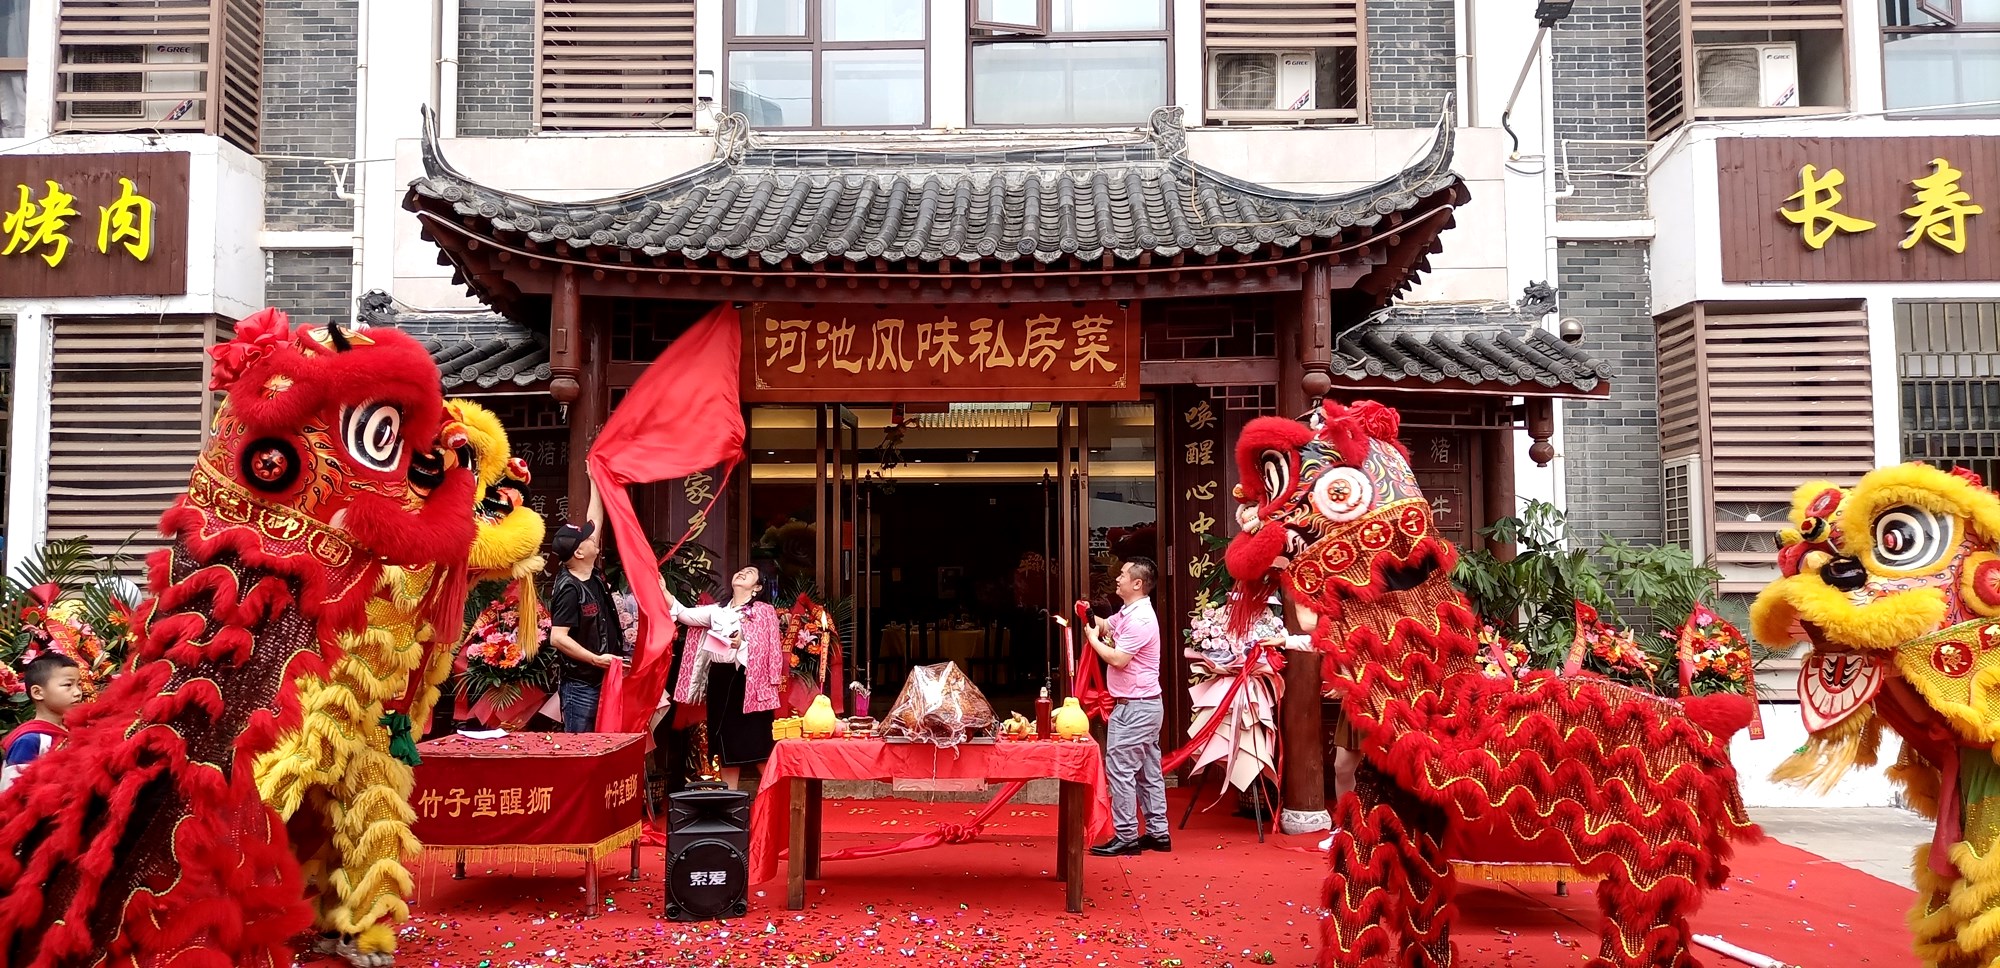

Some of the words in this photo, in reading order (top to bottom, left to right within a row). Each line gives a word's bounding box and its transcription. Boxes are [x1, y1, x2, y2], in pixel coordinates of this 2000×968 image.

[1, 177, 154, 268] 烤肉
[1777, 157, 1984, 254] 长寿
[765, 313, 1118, 374] 河池风味私房菜
[683, 471, 715, 602] 家乡的
[417, 786, 554, 819] 竹子堂醒狮
[690, 870, 727, 886] 索爱
